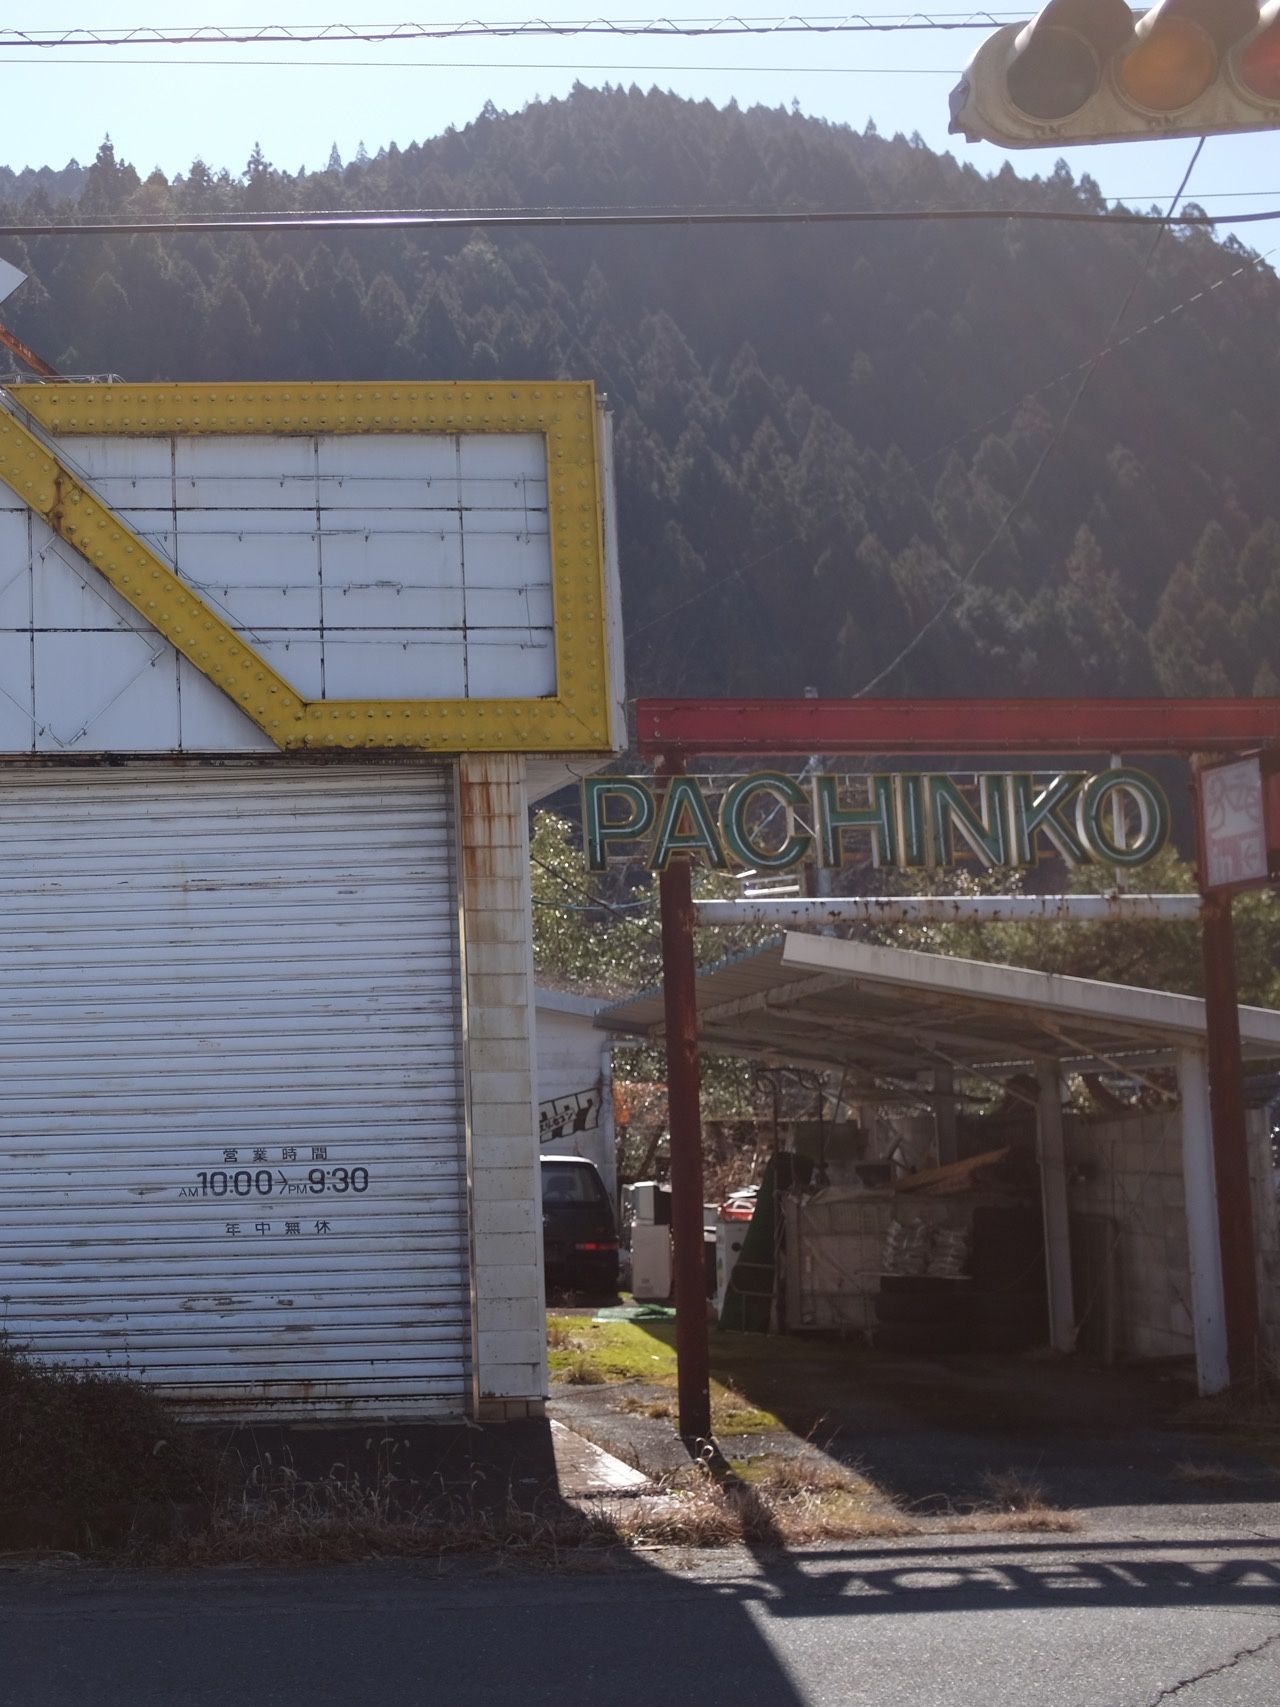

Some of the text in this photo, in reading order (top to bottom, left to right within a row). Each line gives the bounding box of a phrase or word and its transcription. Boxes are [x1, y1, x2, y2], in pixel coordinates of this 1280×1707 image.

[583, 766, 1171, 872] PACHINKO
[223, 1146, 328, 1163] 営業時間
[225, 1220, 332, 1236] 年中無休
